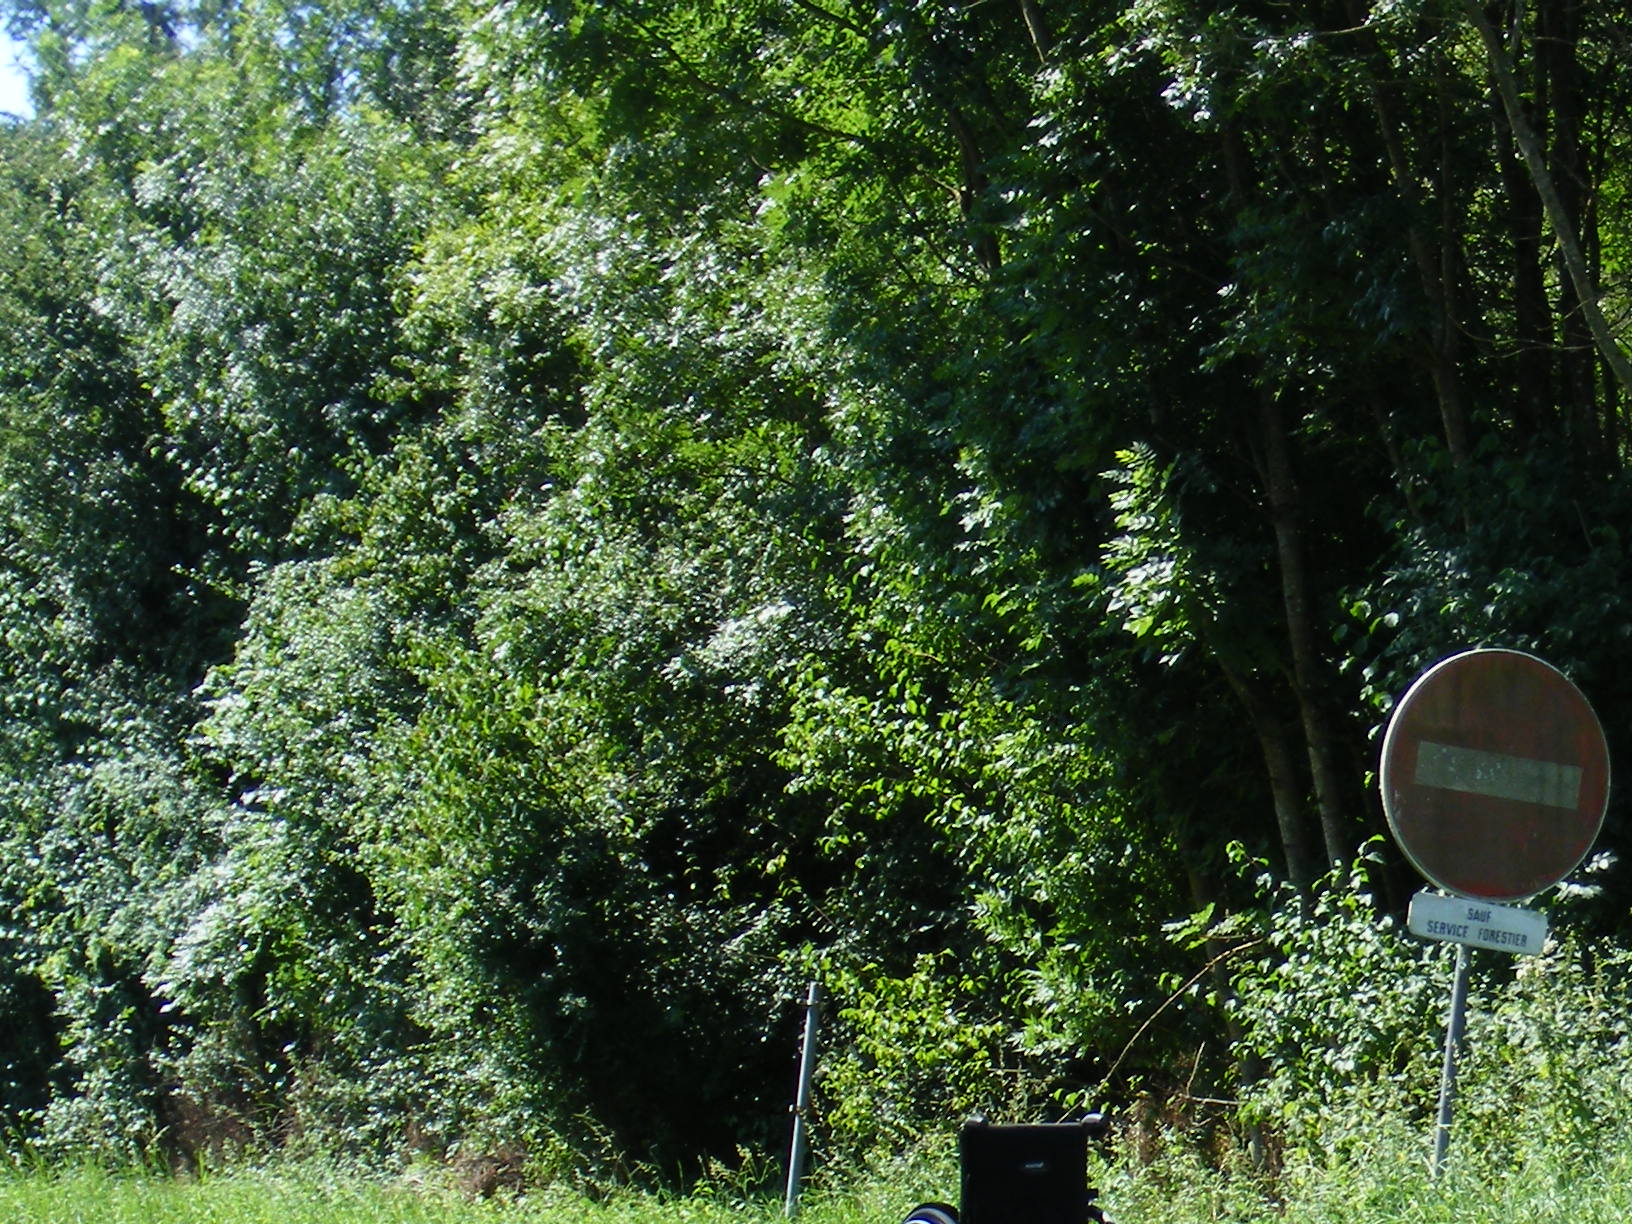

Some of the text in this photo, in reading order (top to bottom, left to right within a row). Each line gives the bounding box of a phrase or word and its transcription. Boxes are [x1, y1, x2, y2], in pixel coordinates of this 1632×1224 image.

[1466, 908, 1493, 923] SAUF
[1427, 920, 1529, 947] SERVICE FORESTIER
